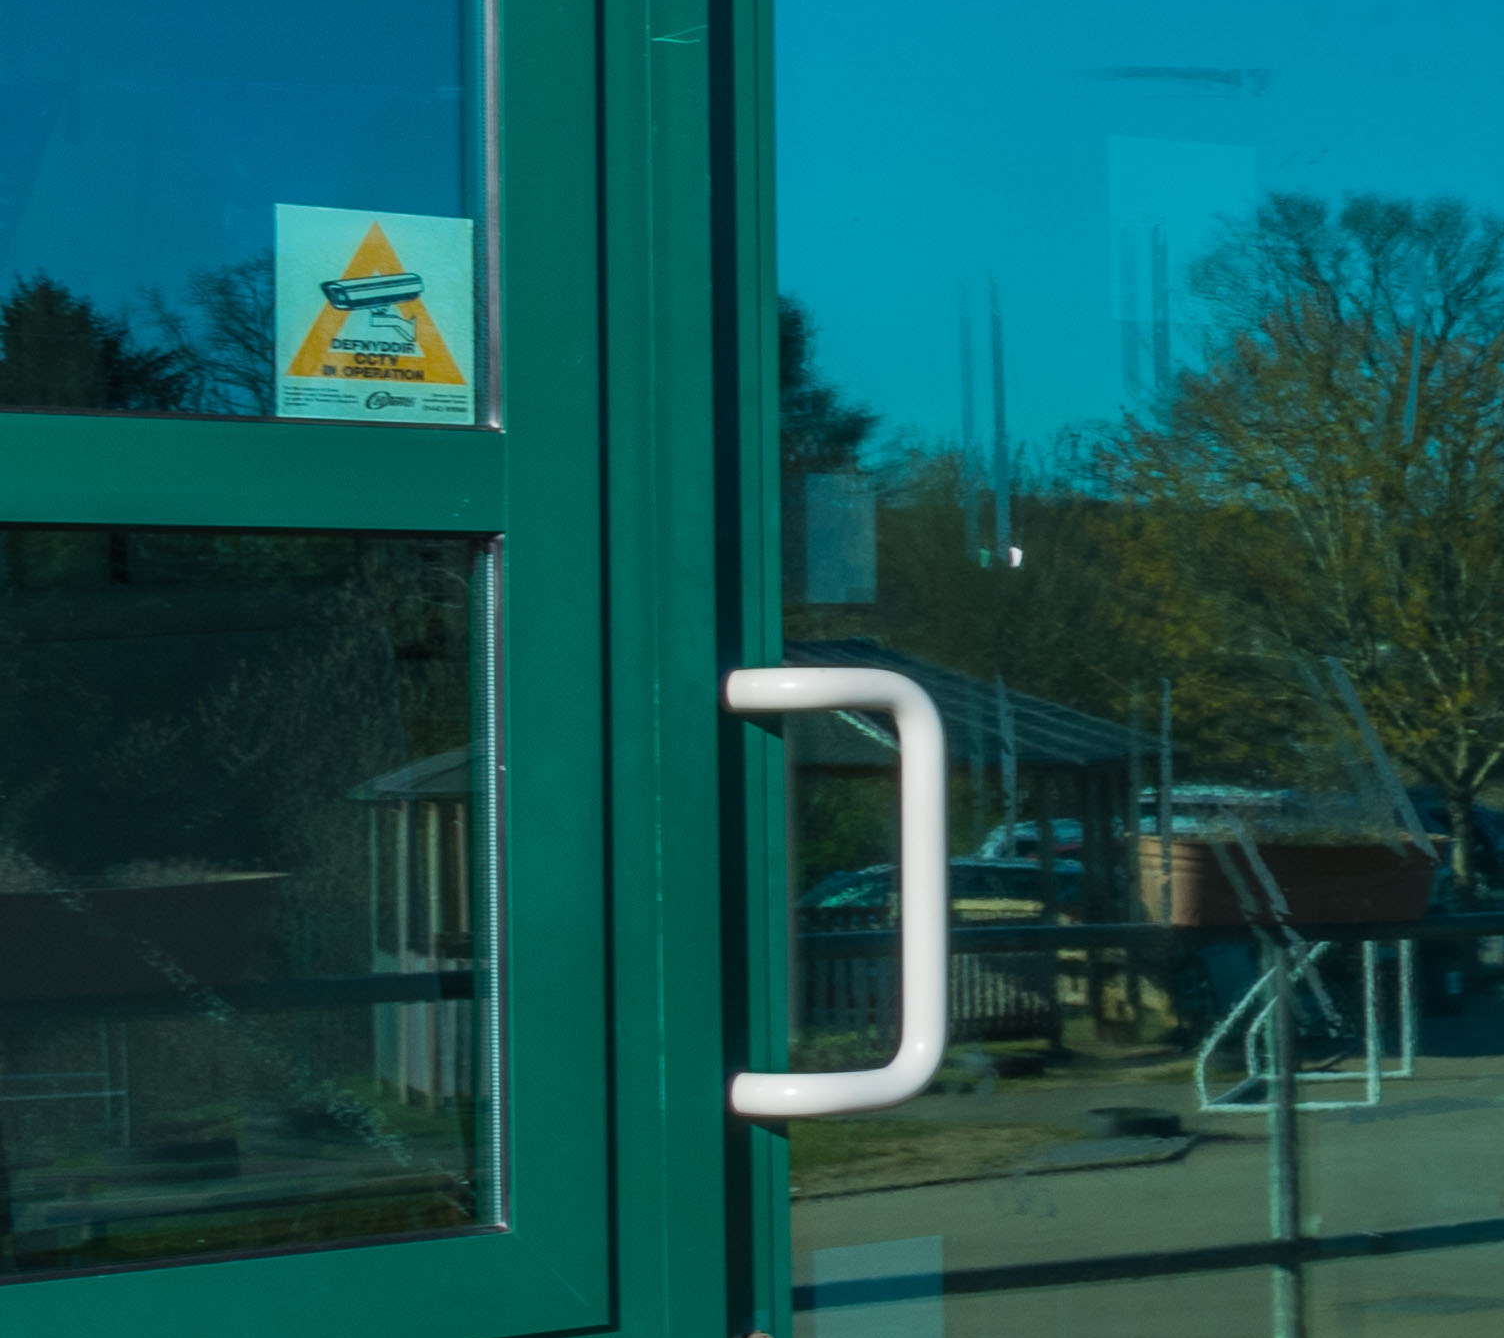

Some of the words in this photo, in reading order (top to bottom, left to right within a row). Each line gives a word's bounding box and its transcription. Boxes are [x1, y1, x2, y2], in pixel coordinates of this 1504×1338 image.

[331, 338, 416, 354] DEFNYDDIR
[354, 352, 399, 366] CCTV
[323, 365, 337, 376] IN
[343, 366, 425, 381] OPERATION
